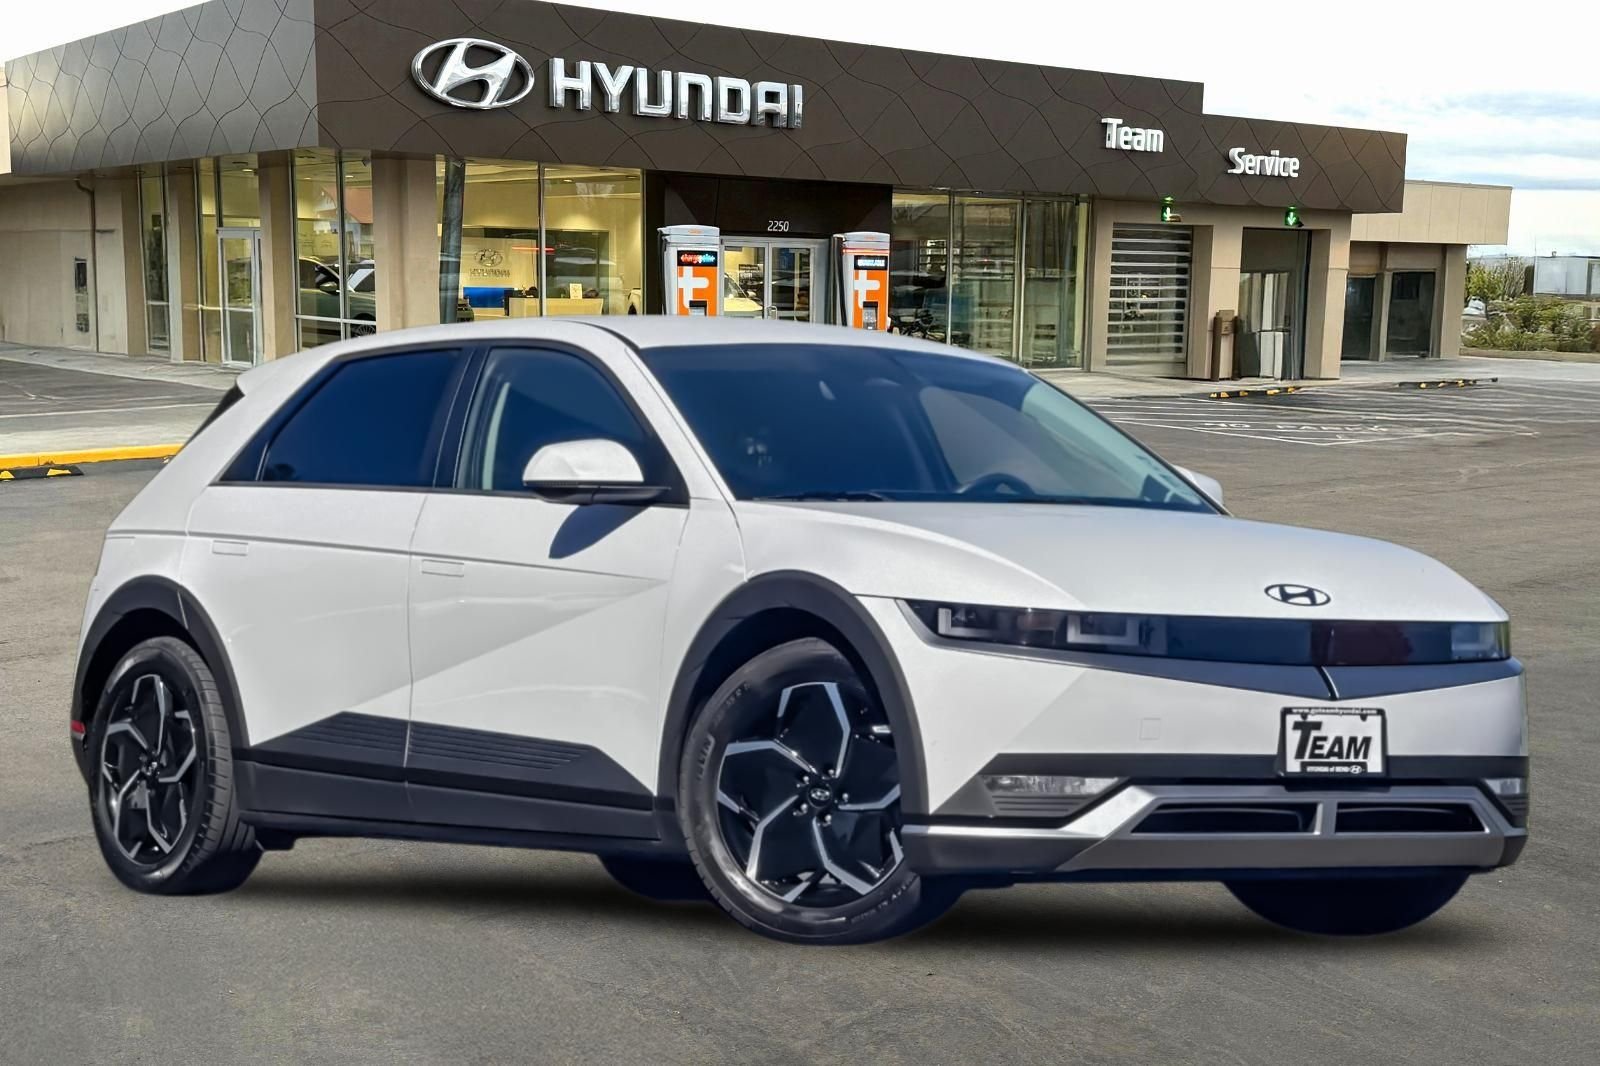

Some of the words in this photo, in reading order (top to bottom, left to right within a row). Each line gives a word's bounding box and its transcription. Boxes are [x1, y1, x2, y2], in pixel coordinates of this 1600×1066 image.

[548, 57, 804, 129] HYUNDAI
[1101, 117, 1164, 153] Team
[1227, 147, 1300, 178] Service
[767, 220, 790, 232] 2250
